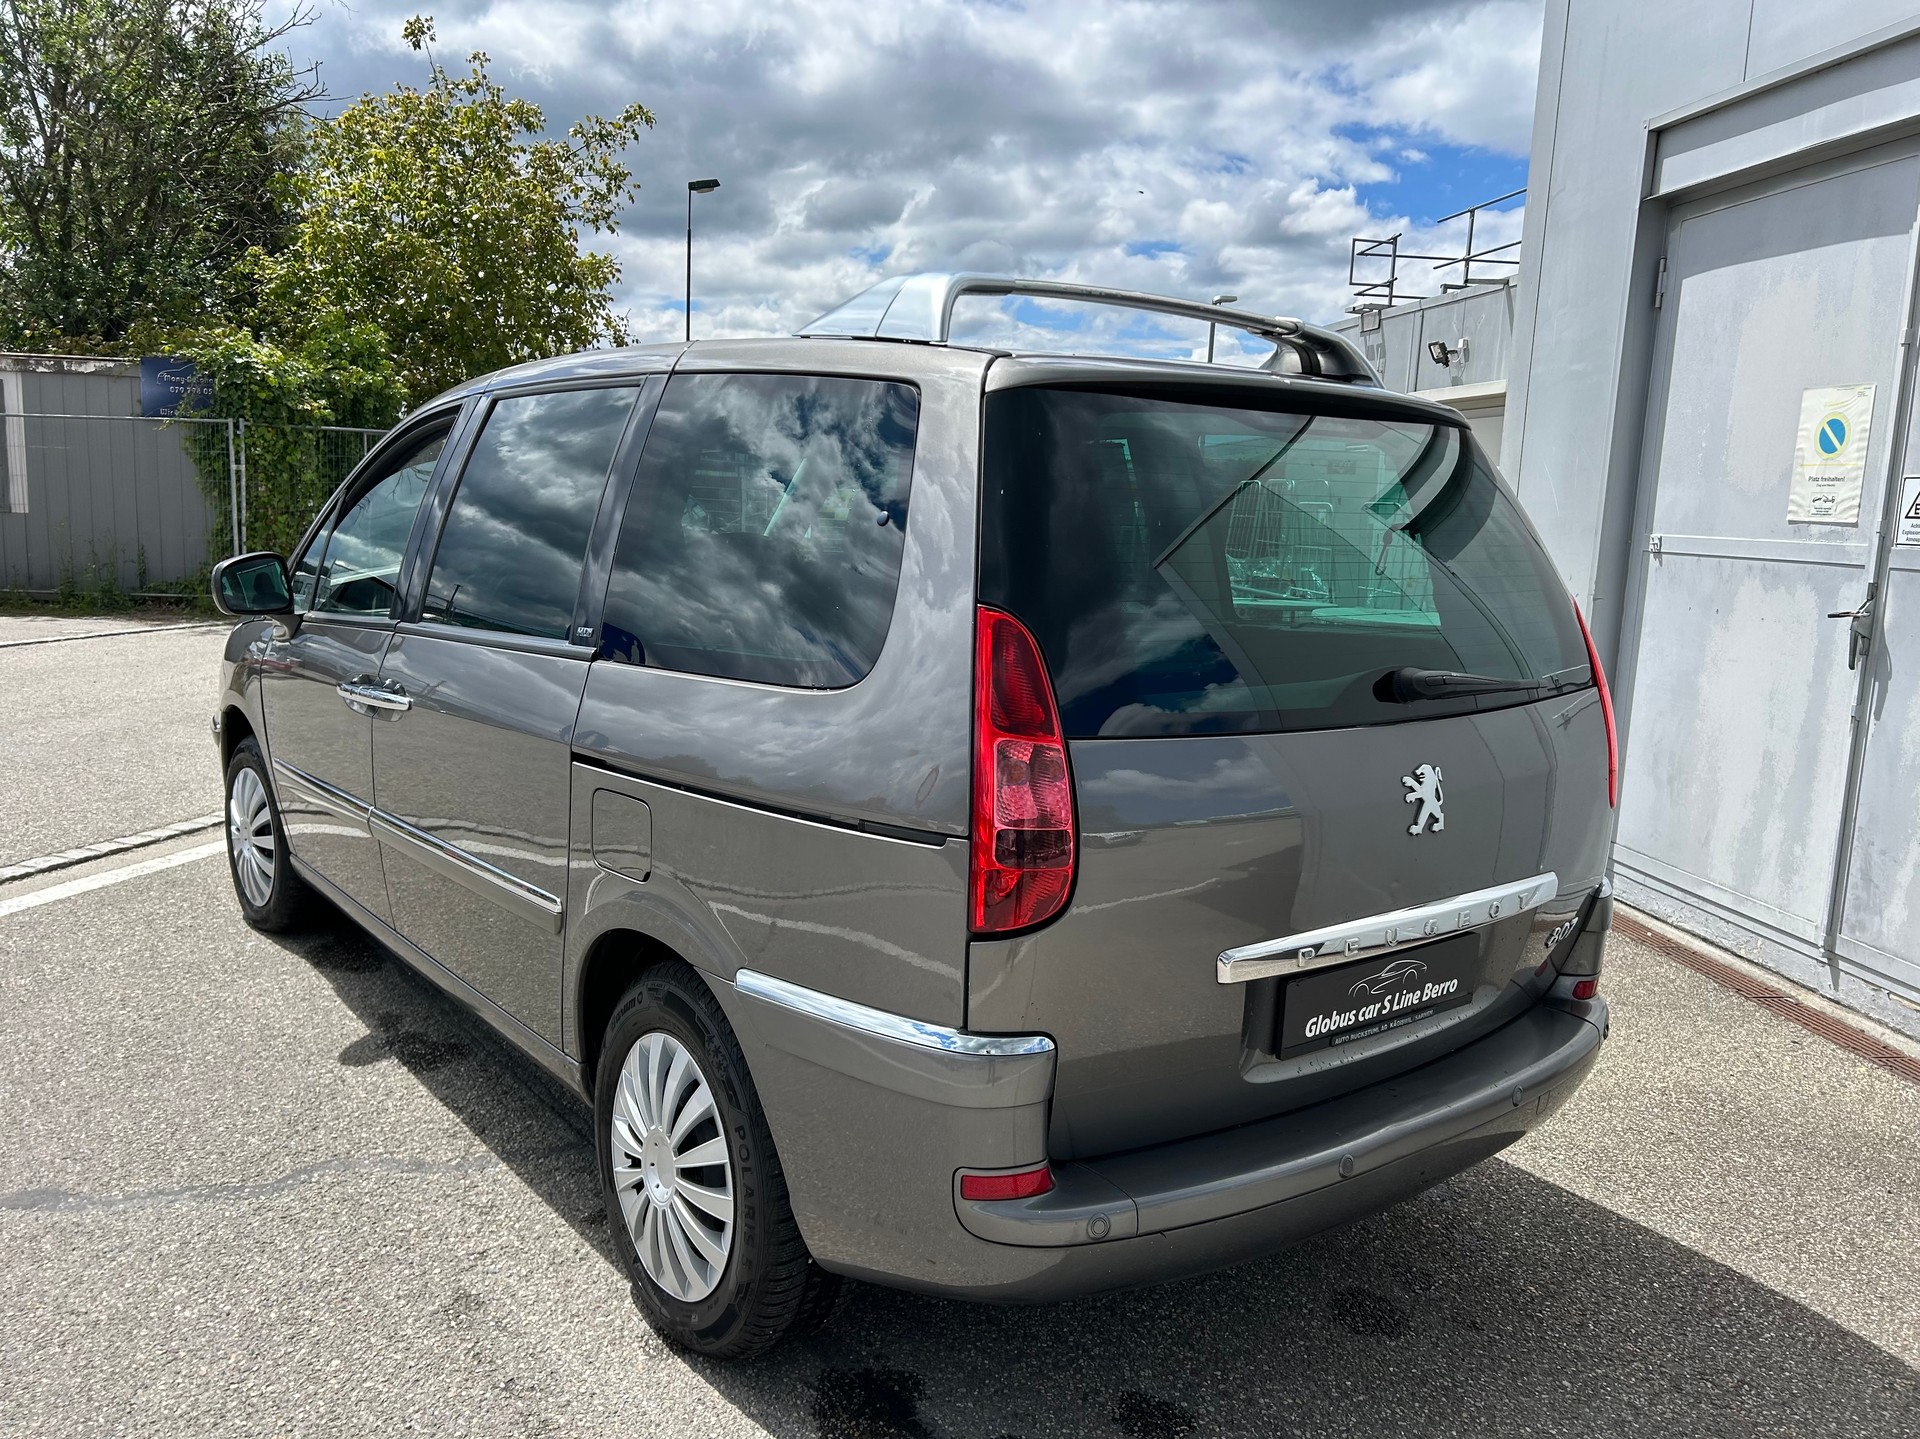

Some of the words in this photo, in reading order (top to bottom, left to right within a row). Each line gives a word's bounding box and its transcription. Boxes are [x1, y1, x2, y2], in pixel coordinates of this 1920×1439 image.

[1297, 892, 1530, 967] PEUGEOT
[1547, 916, 1579, 947] 807
[1304, 1007, 1356, 1038] Globus
[1358, 1002, 1382, 1022] car
[1382, 997, 1392, 1015] S
[1392, 990, 1420, 1012] Line
[1422, 978, 1459, 1002] Berro
[1334, 1035, 1349, 1045] AUTO
[1380, 1024, 1388, 1032] AG
[734, 1125, 755, 1249] POLARIS
